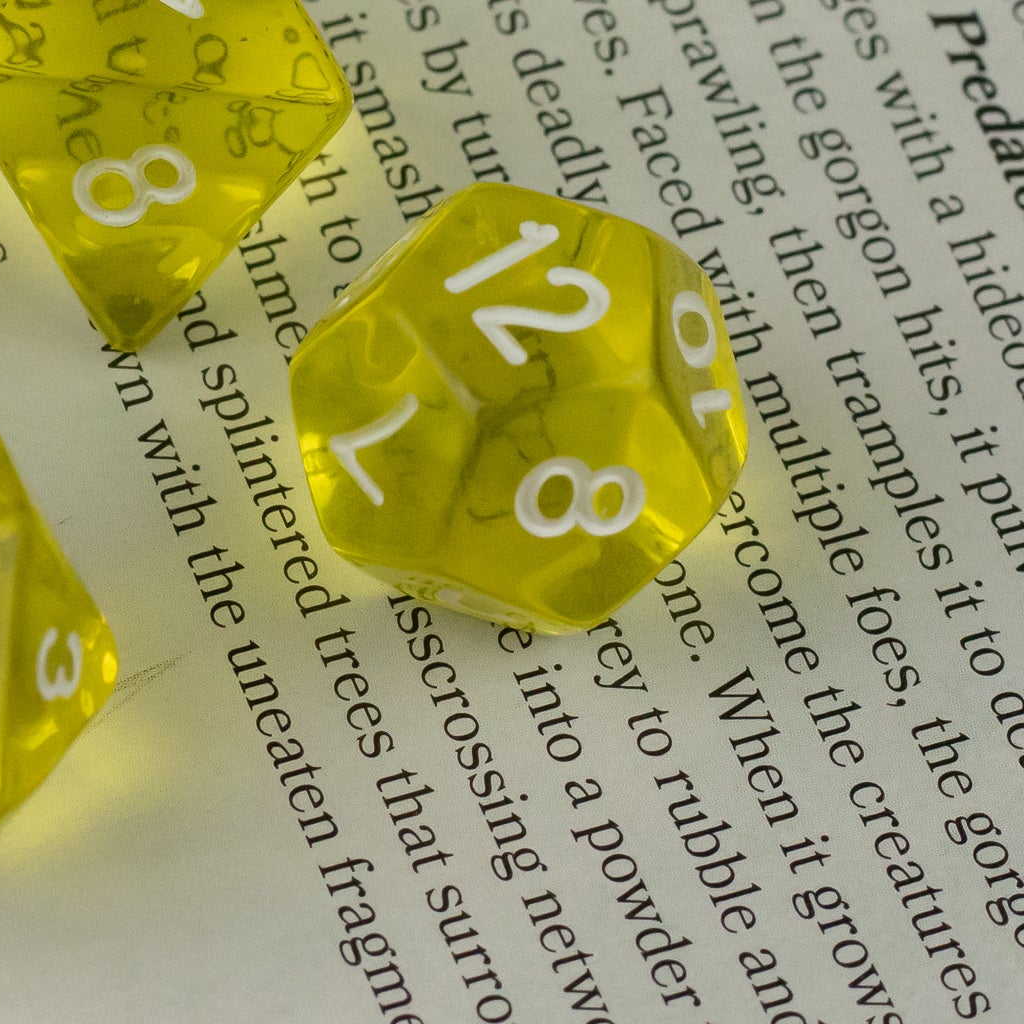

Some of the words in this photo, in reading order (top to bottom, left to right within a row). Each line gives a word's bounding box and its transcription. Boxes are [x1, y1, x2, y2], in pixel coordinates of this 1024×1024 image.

[768, 34, 828, 115] the
[72, 143, 198, 228] 8
[875, 69, 956, 182] with
[927, 194, 966, 225] a
[319, 215, 364, 265] to
[797, 127, 913, 299] gorgon
[443, 219, 612, 367] 12
[768, 225, 843, 340] then
[670, 289, 732, 428] 10
[893, 303, 963, 417] hits,
[320, 11, 368, 49] it
[627, 706, 673, 758] to
[653, 769, 762, 934] rubble
[329, 392, 419, 507] 7
[419, 37, 474, 97] by
[451, 110, 511, 183] tur
[708, 665, 799, 828] When
[779, 834, 832, 875] it
[513, 455, 648, 539] 8
[615, 84, 725, 240] Faced
[697, 246, 774, 362] with
[743, 371, 870, 576] multiple
[845, 586, 922, 708] foes,
[910, 716, 974, 799] the
[825, 348, 954, 572] tramples
[950, 424, 1000, 464] it
[511, 47, 612, 205] deadly
[724, 491, 820, 675] ercome
[802, 685, 865, 768] the
[848, 780, 992, 1020] creatures
[137, 418, 218, 537] with
[186, 545, 246, 629] the
[226, 639, 340, 849] uneaten
[198, 363, 352, 619] splintered
[314, 627, 396, 759] trees
[375, 768, 454, 874] that
[934, 579, 985, 619] it
[959, 627, 1006, 677] to
[35, 626, 83, 702] 3
[512, 663, 583, 763] into
[564, 778, 603, 810] a
[569, 818, 702, 1008] powder
